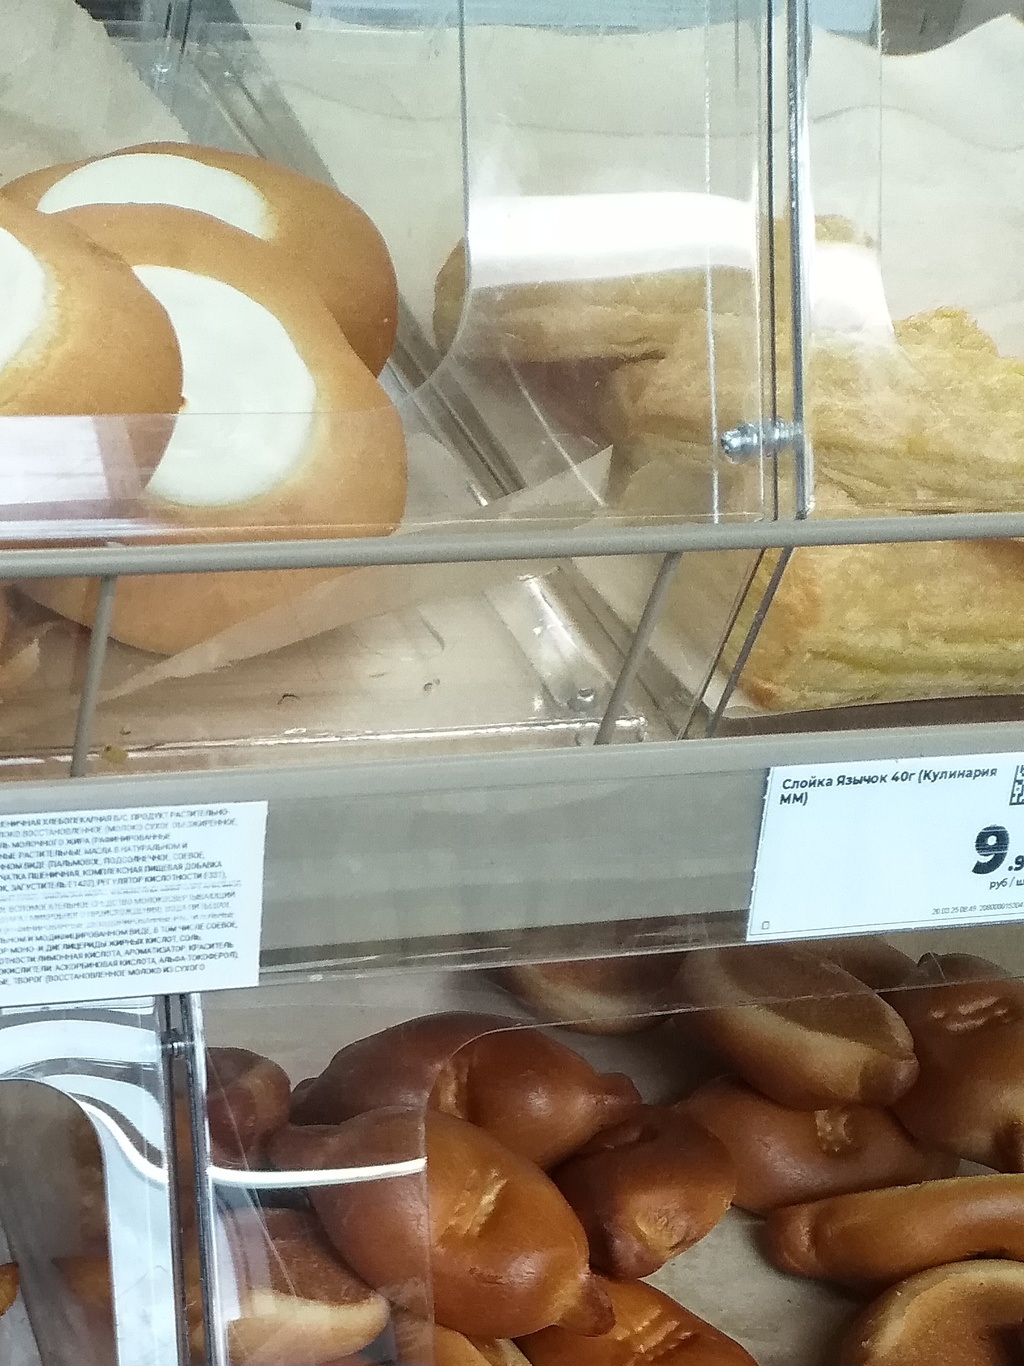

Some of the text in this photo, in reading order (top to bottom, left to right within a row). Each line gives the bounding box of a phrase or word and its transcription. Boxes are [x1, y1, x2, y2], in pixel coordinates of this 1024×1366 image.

[782, 766, 997, 790] Слойка Язычок 40г (Кулинария
[780, 792, 808, 806] ММ)
[989, 878, 1008, 890] руб
